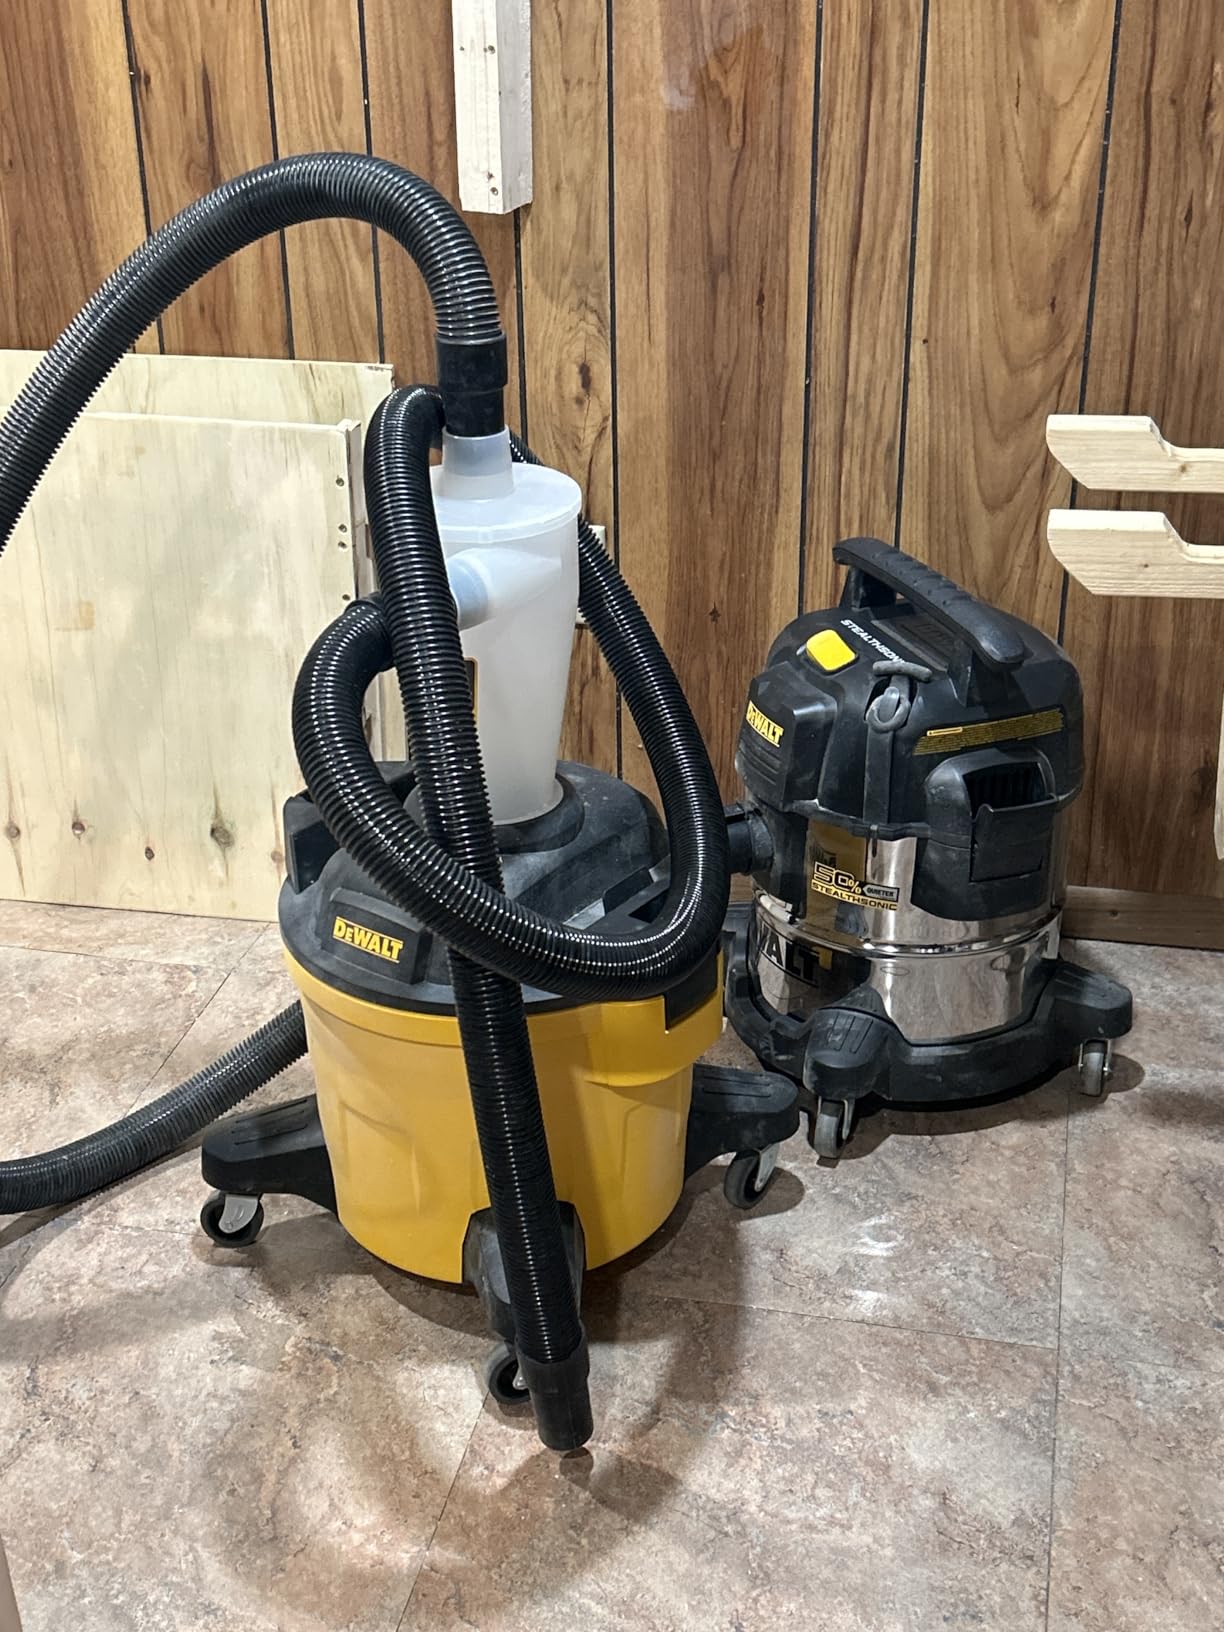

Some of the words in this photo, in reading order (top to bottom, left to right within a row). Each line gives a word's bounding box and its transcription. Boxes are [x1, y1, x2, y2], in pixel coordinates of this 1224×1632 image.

[840, 619, 905, 663] STEALTHSON
[814, 861, 862, 895] 50%
[812, 880, 898, 911] STEALTHSONIC
